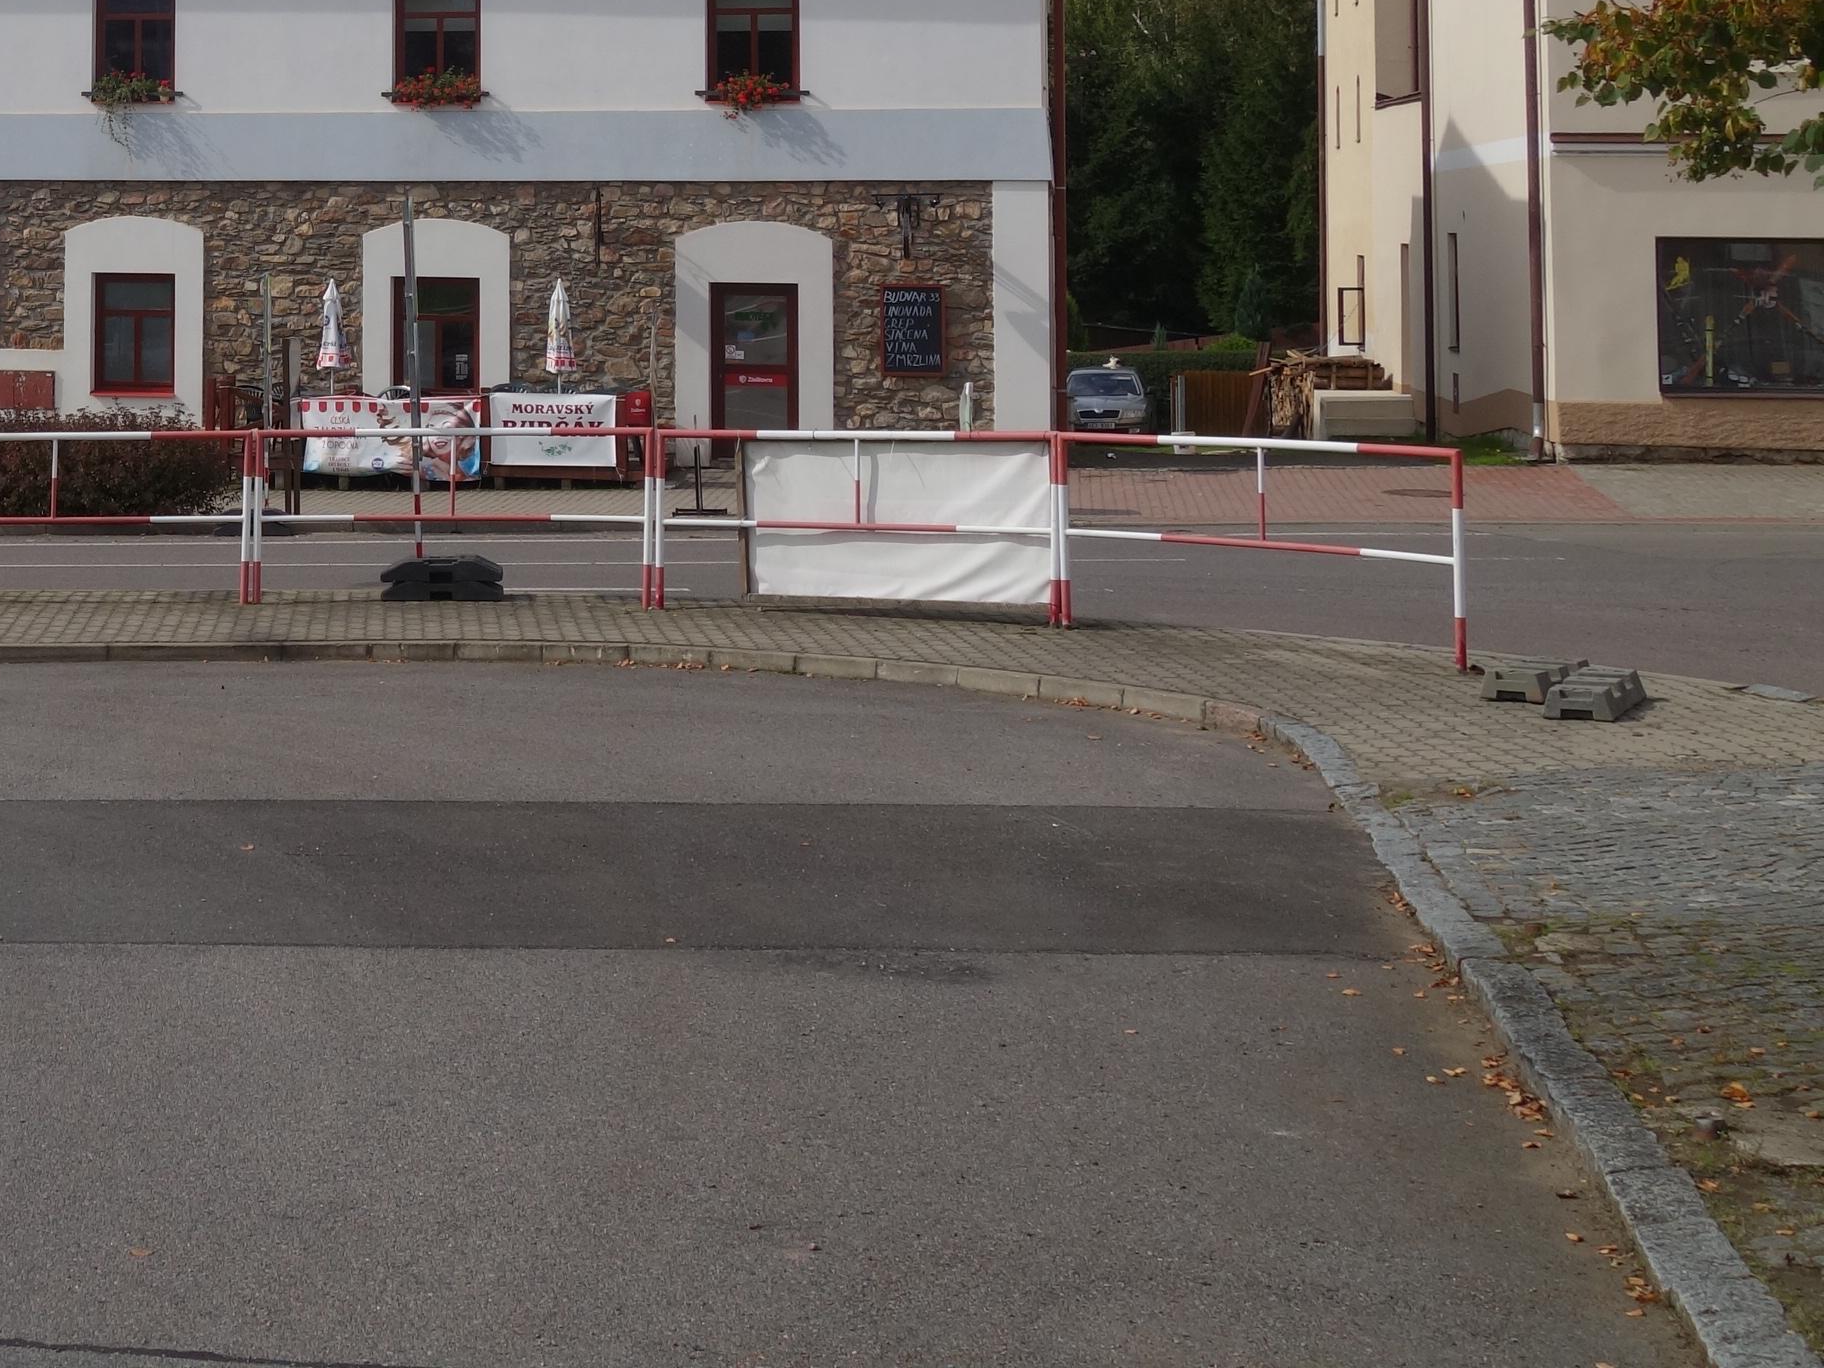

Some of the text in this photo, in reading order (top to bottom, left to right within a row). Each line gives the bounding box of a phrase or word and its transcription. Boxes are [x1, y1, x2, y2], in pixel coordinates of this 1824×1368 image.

[884, 291, 940, 303] BUDVAR 33
[886, 354, 941, 368] ZMRZLINA
[511, 402, 595, 414] MORAVSKÝ
